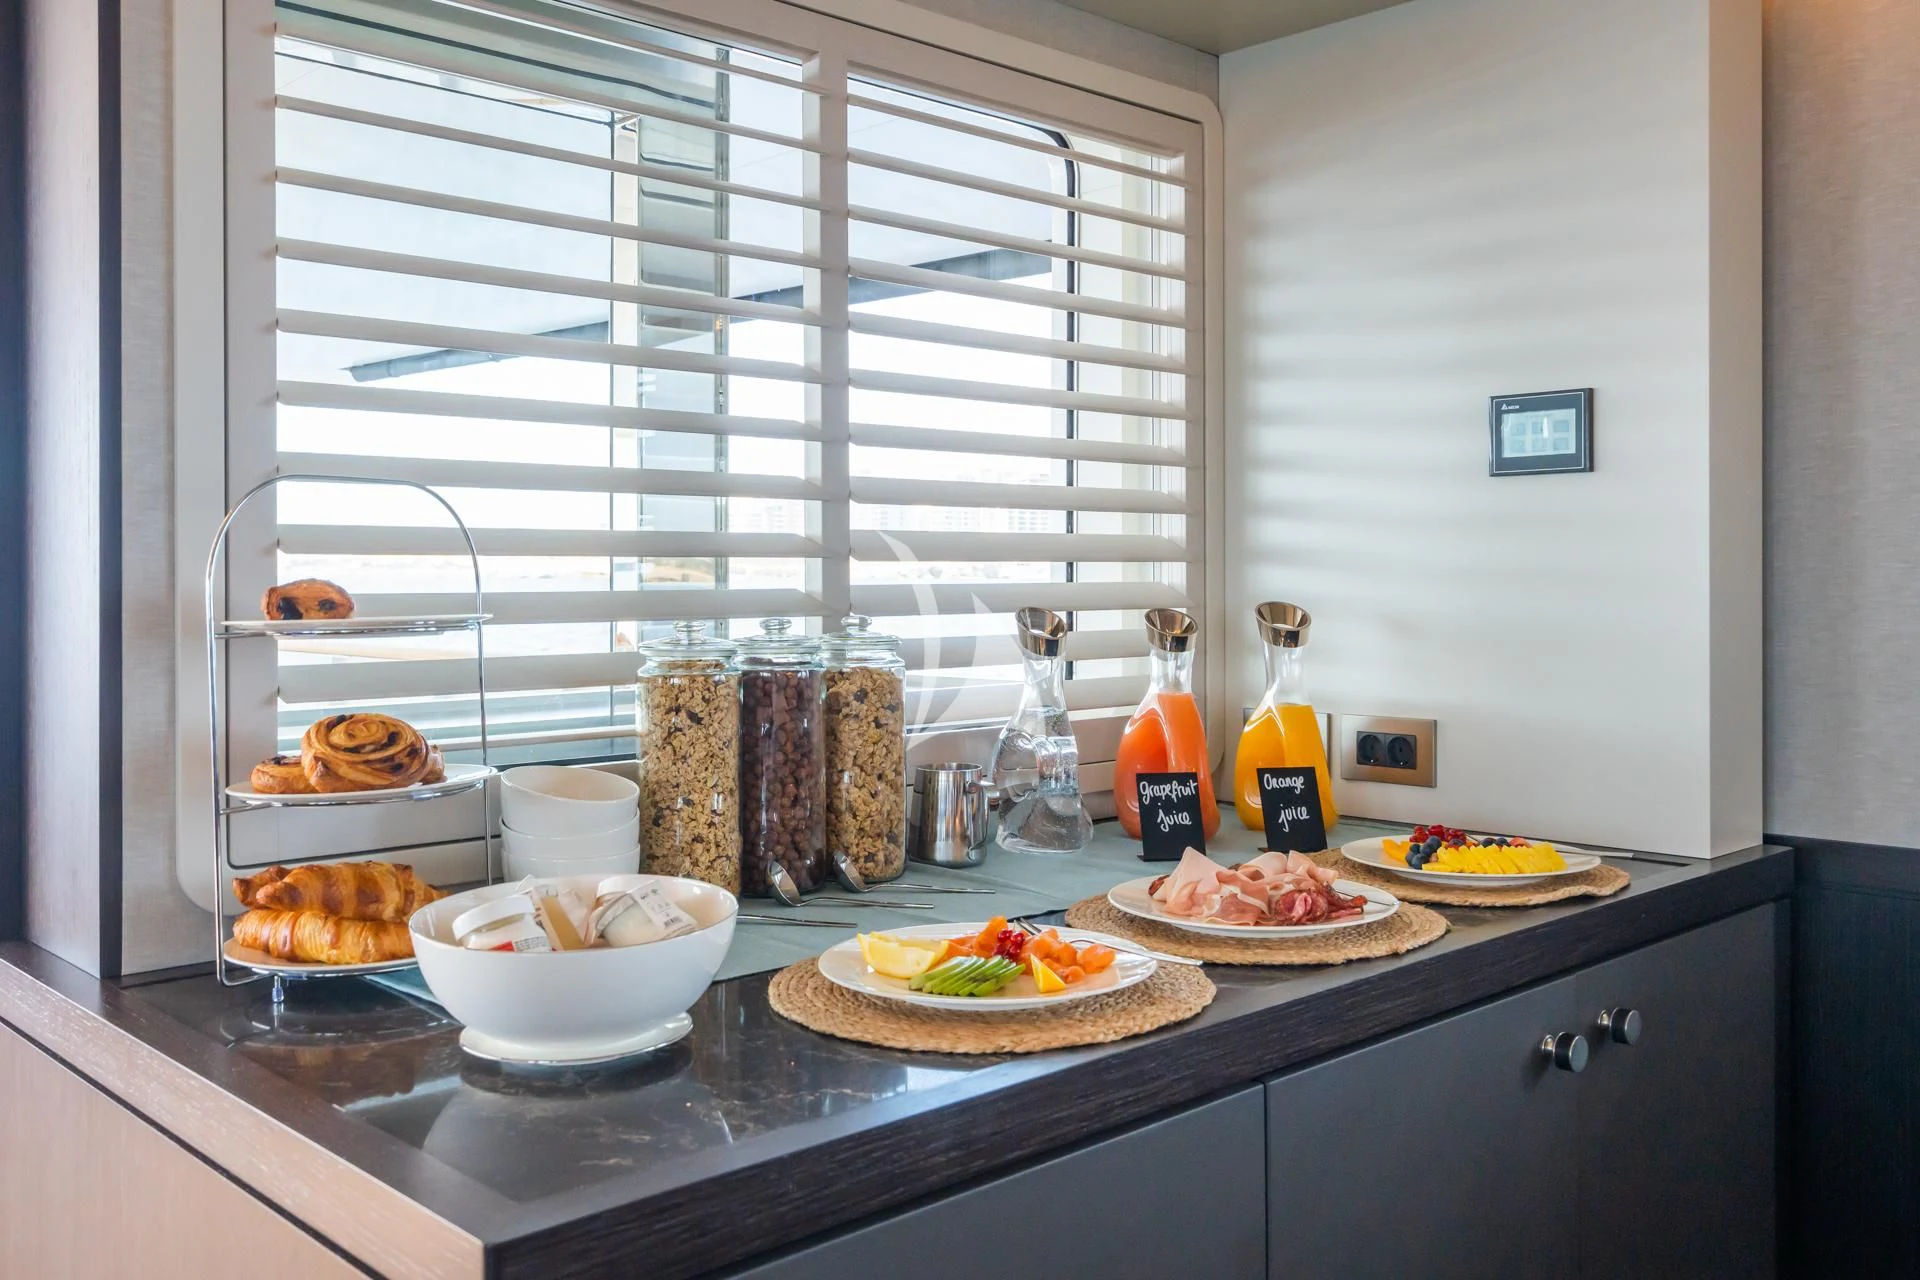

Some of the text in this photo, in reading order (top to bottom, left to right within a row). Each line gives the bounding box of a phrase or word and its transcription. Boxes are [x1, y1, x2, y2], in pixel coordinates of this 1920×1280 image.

[1263, 773, 1305, 795] Orange
[1157, 802, 1192, 832] juice
[1278, 803, 1310, 832] juice
